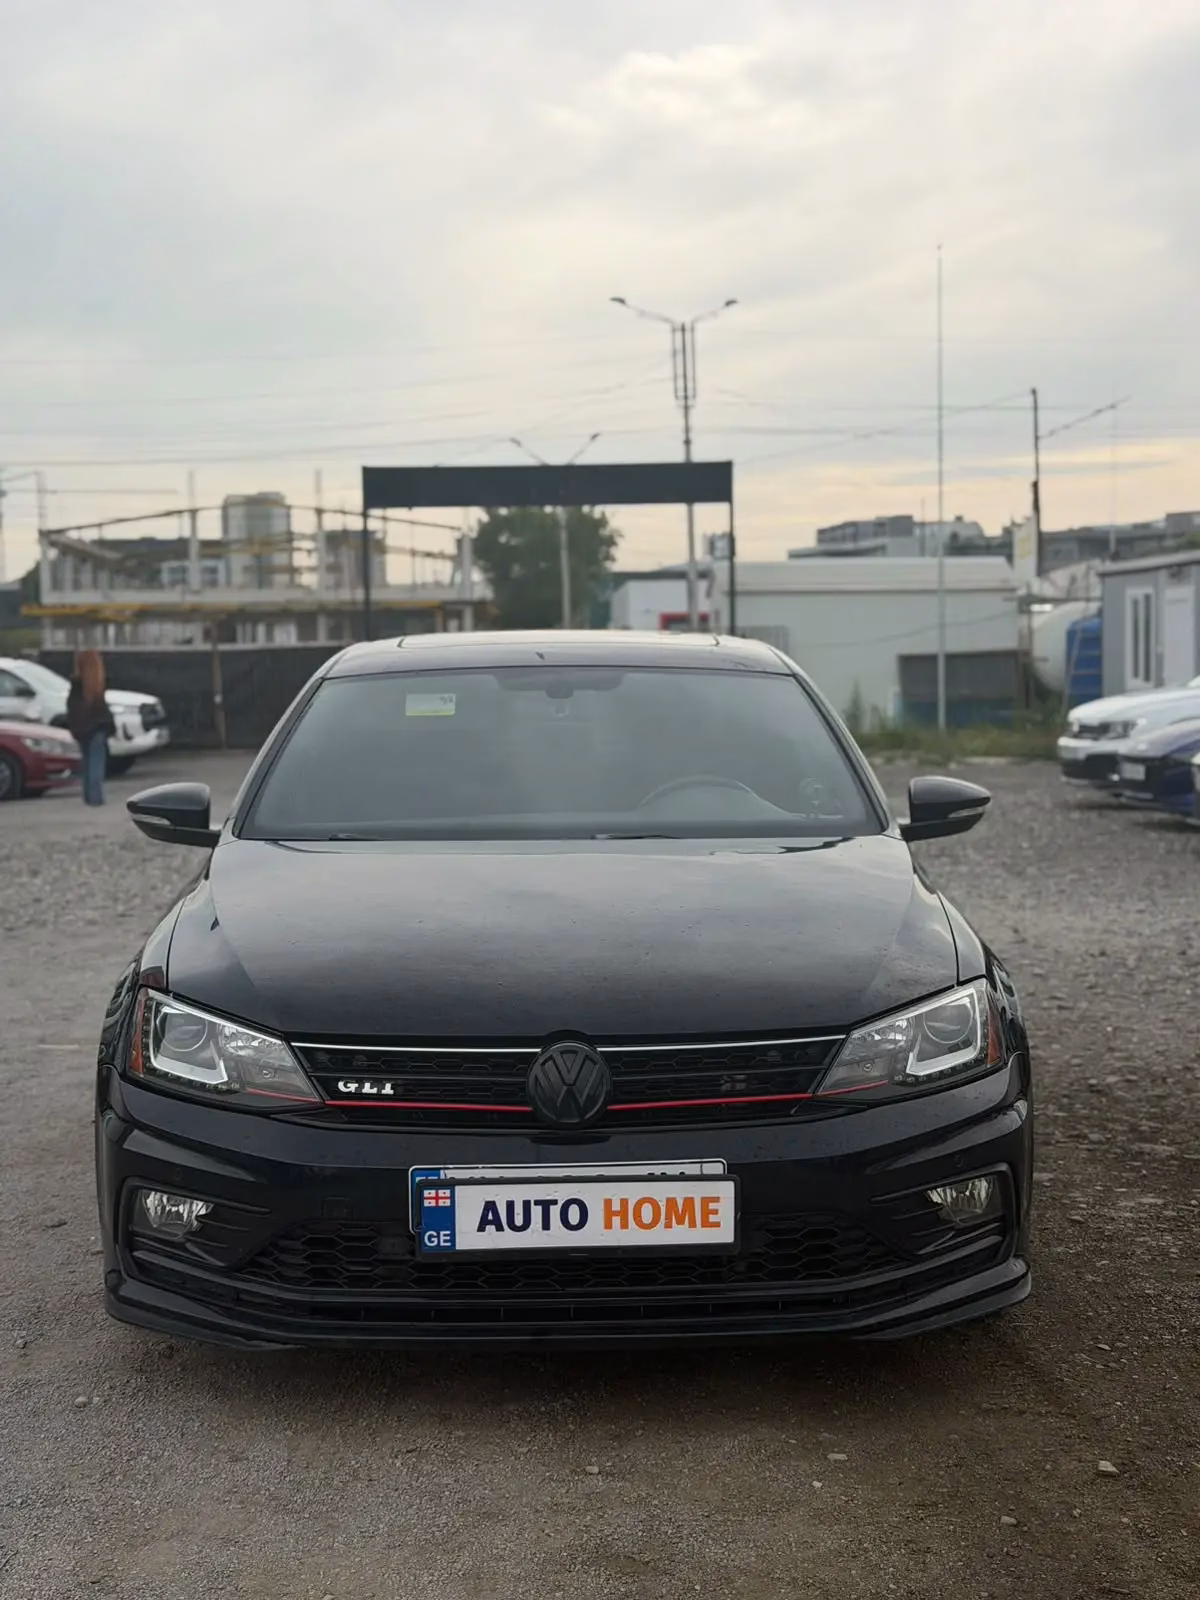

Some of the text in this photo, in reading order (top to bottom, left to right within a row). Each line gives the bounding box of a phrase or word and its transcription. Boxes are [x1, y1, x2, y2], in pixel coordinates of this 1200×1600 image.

[337, 1079, 395, 1095] GLI
[529, 1042, 610, 1123] VW
[476, 1196, 721, 1233] AUTO HOME
[424, 1230, 452, 1247] GE
